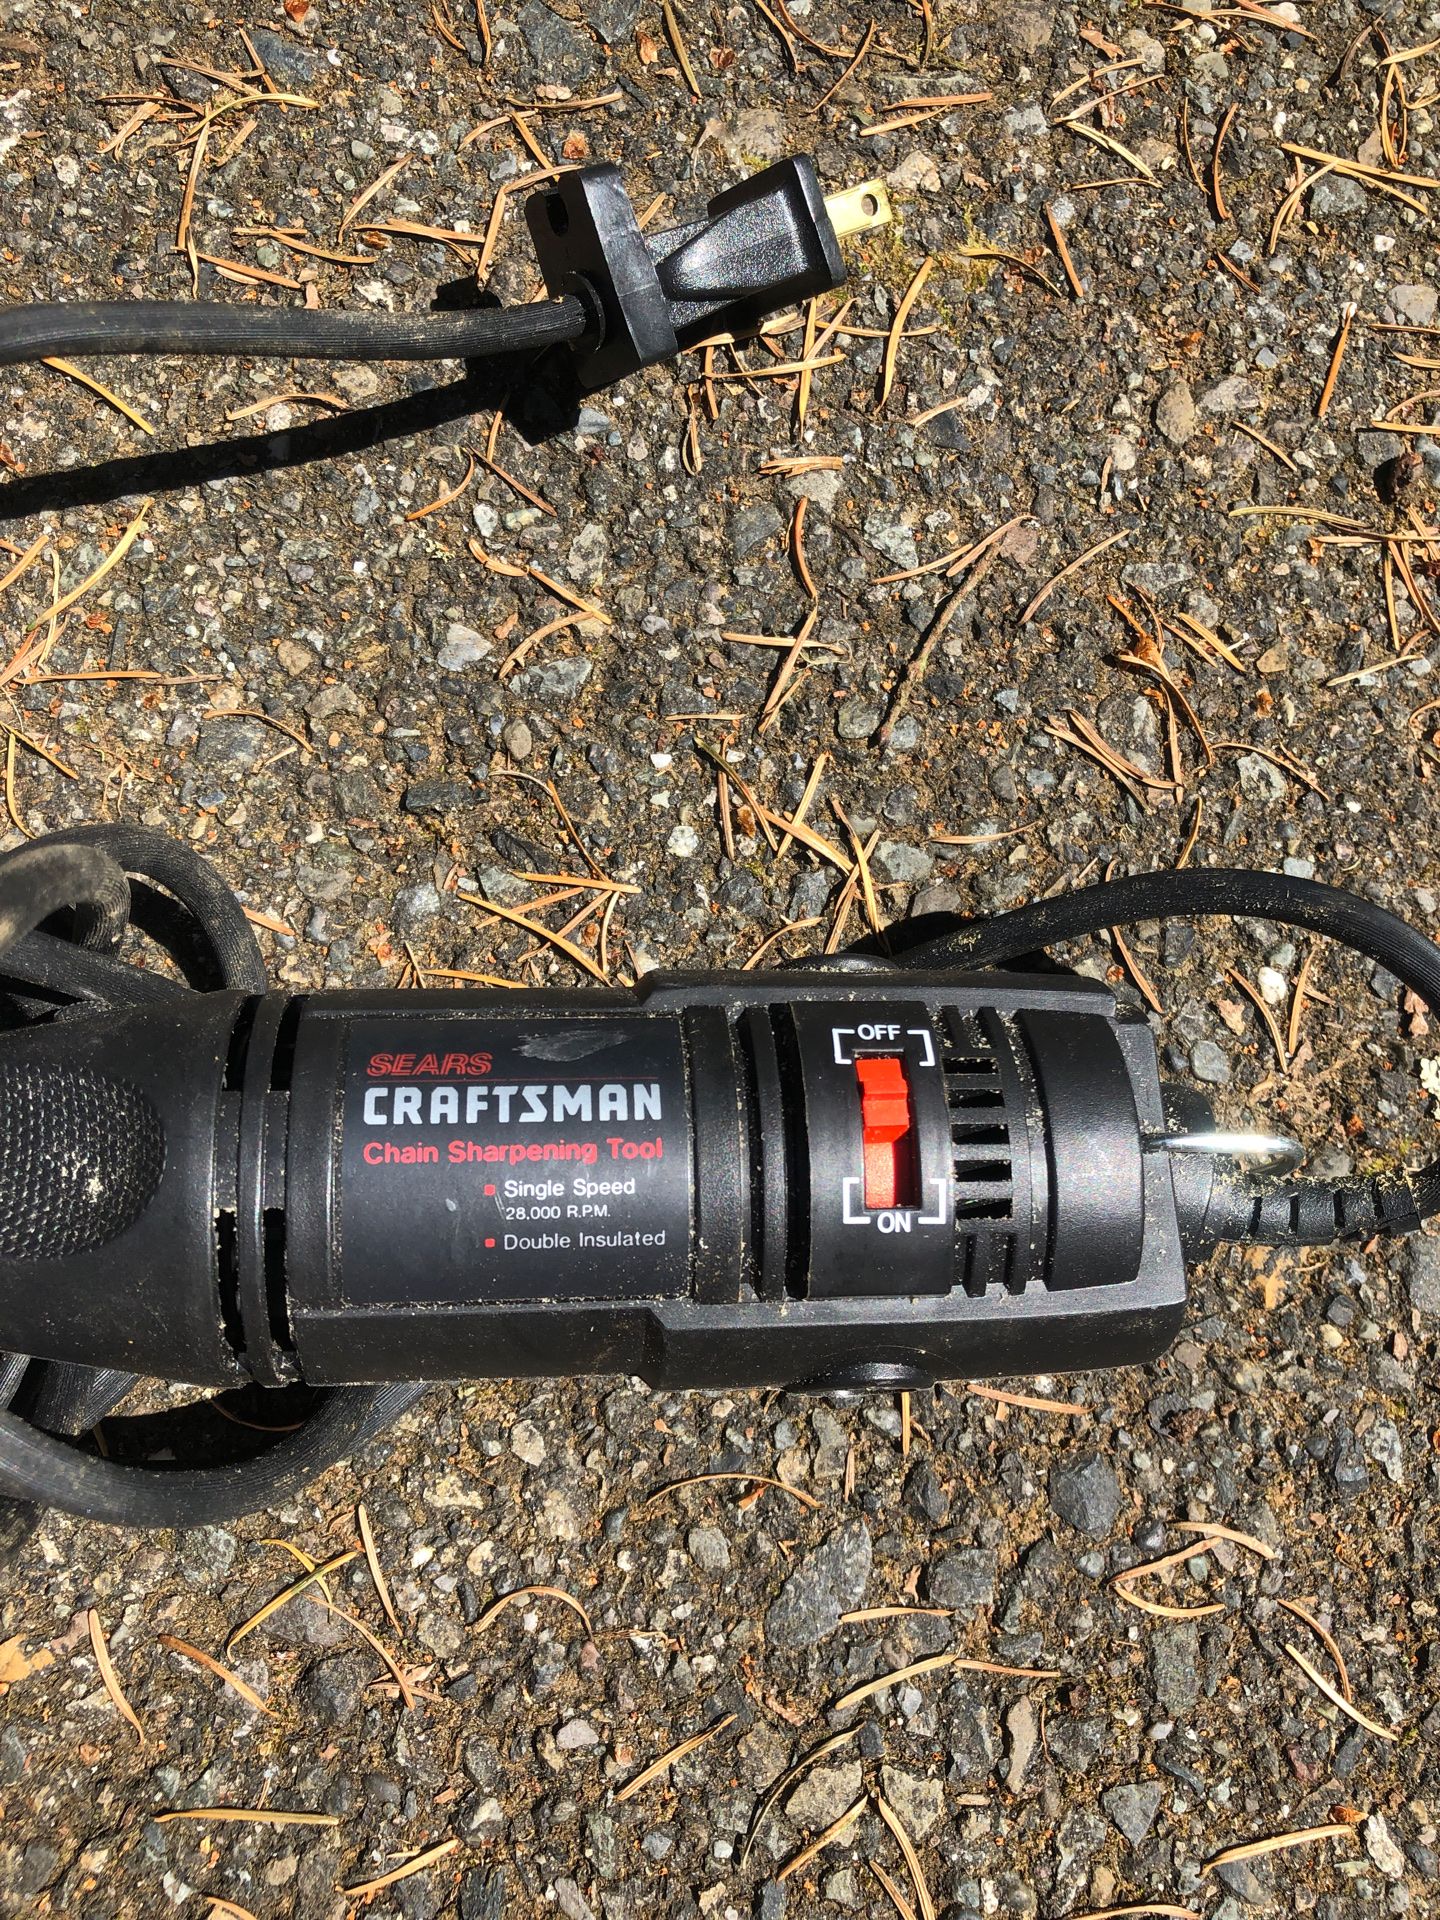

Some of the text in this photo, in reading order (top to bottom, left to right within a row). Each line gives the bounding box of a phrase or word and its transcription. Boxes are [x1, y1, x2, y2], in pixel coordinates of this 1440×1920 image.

[857, 1024, 900, 1040] OFF
[366, 1052, 493, 1077] SEARS
[363, 1083, 662, 1125] CRAFTSMAN
[363, 1136, 663, 1165] Chain Sharpening Tool
[503, 1178, 636, 1200] Single Speed
[567, 1204, 611, 1219] R.P.M.
[877, 1212, 911, 1233] ON
[504, 1229, 666, 1251] Double Insulated
